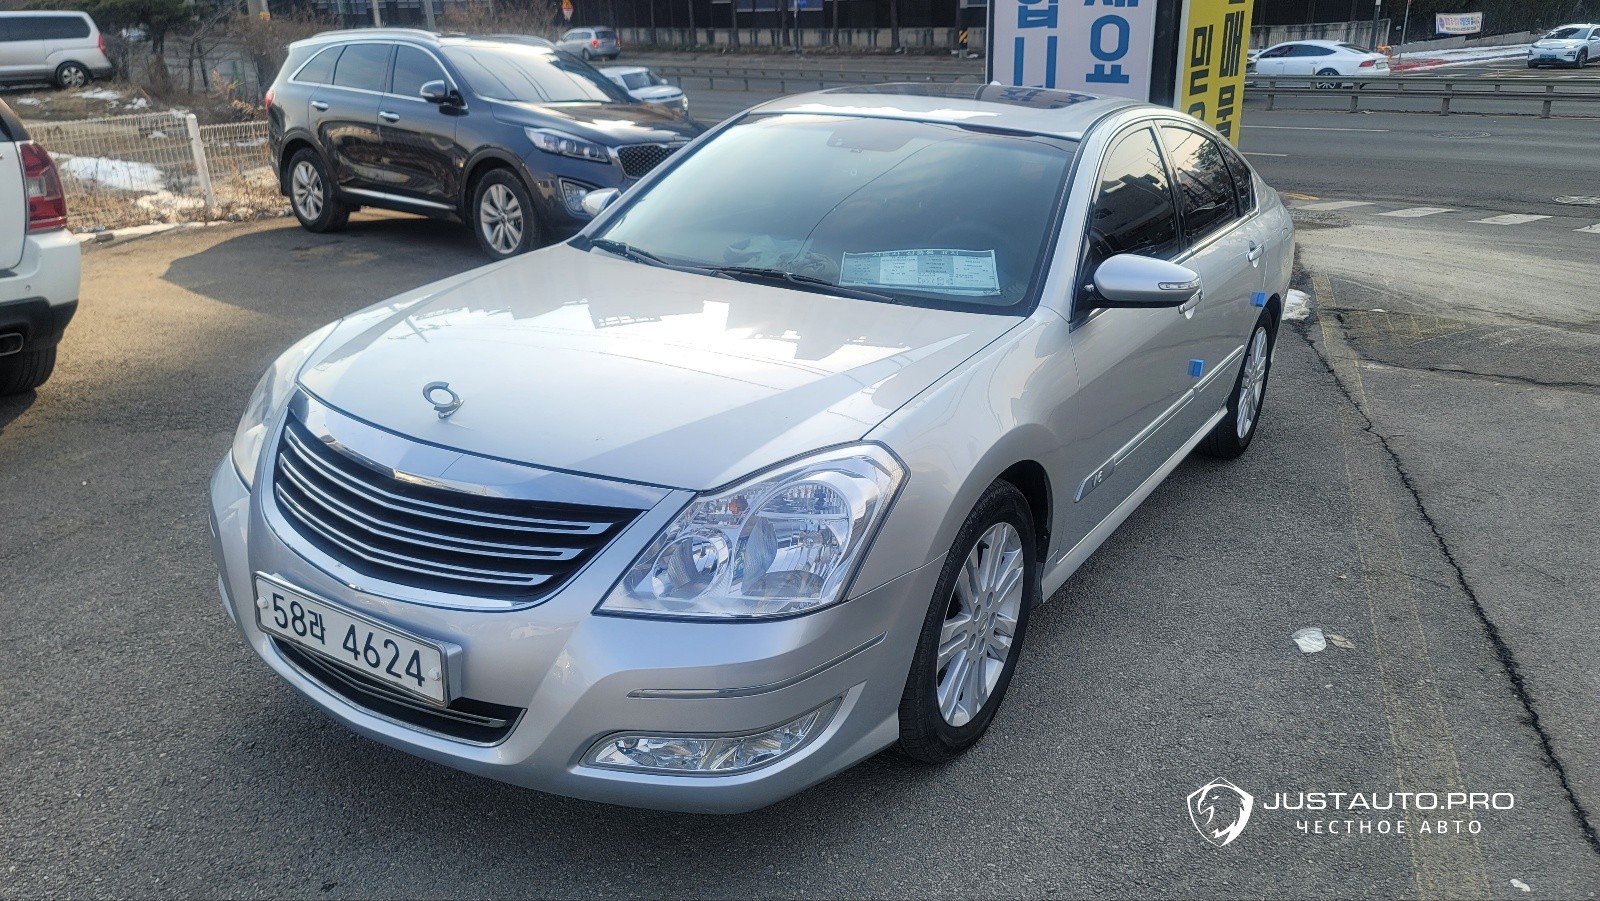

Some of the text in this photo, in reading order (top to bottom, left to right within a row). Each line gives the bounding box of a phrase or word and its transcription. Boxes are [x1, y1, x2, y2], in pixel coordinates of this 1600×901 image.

[1084, 0, 1138, 84] 요
[272, 592, 426, 687] 58라 4624
